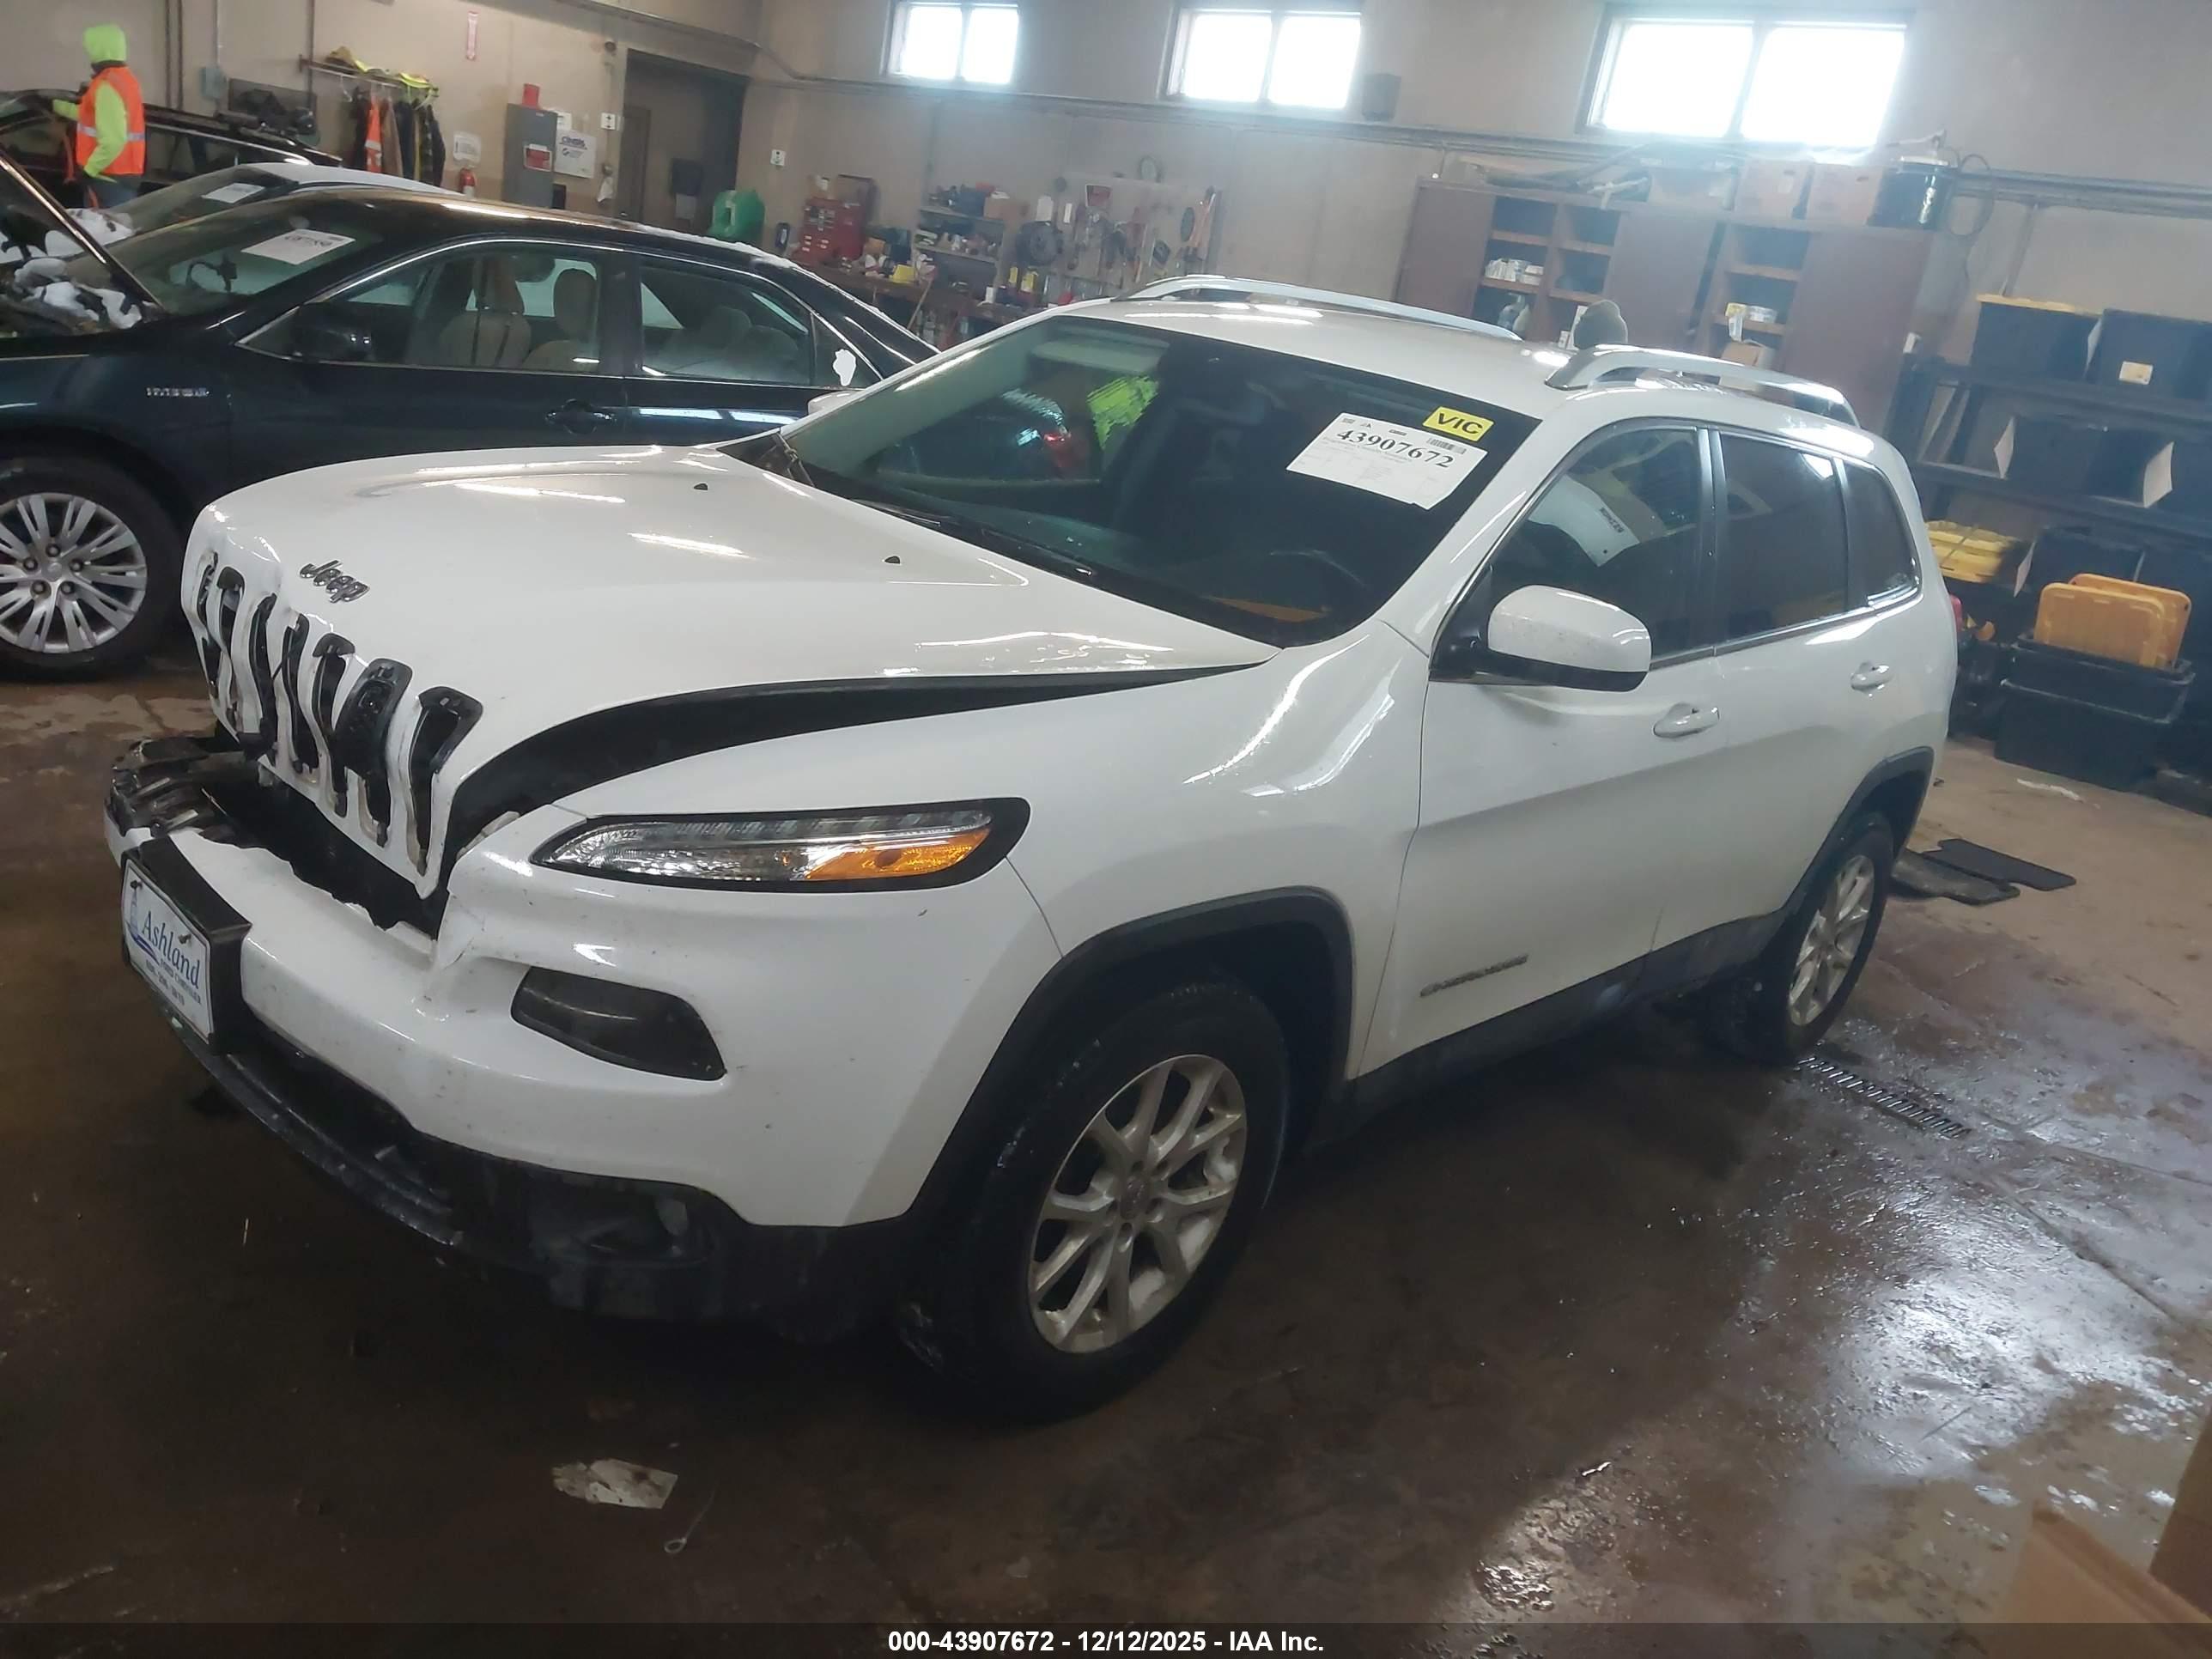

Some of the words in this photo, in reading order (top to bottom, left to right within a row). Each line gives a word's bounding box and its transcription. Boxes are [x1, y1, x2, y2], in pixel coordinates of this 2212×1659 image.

[1437, 412, 1484, 434] VIC
[1336, 428, 1455, 469] 43907672
[299, 559, 370, 604] Jeep
[141, 910, 201, 990] Ashland
